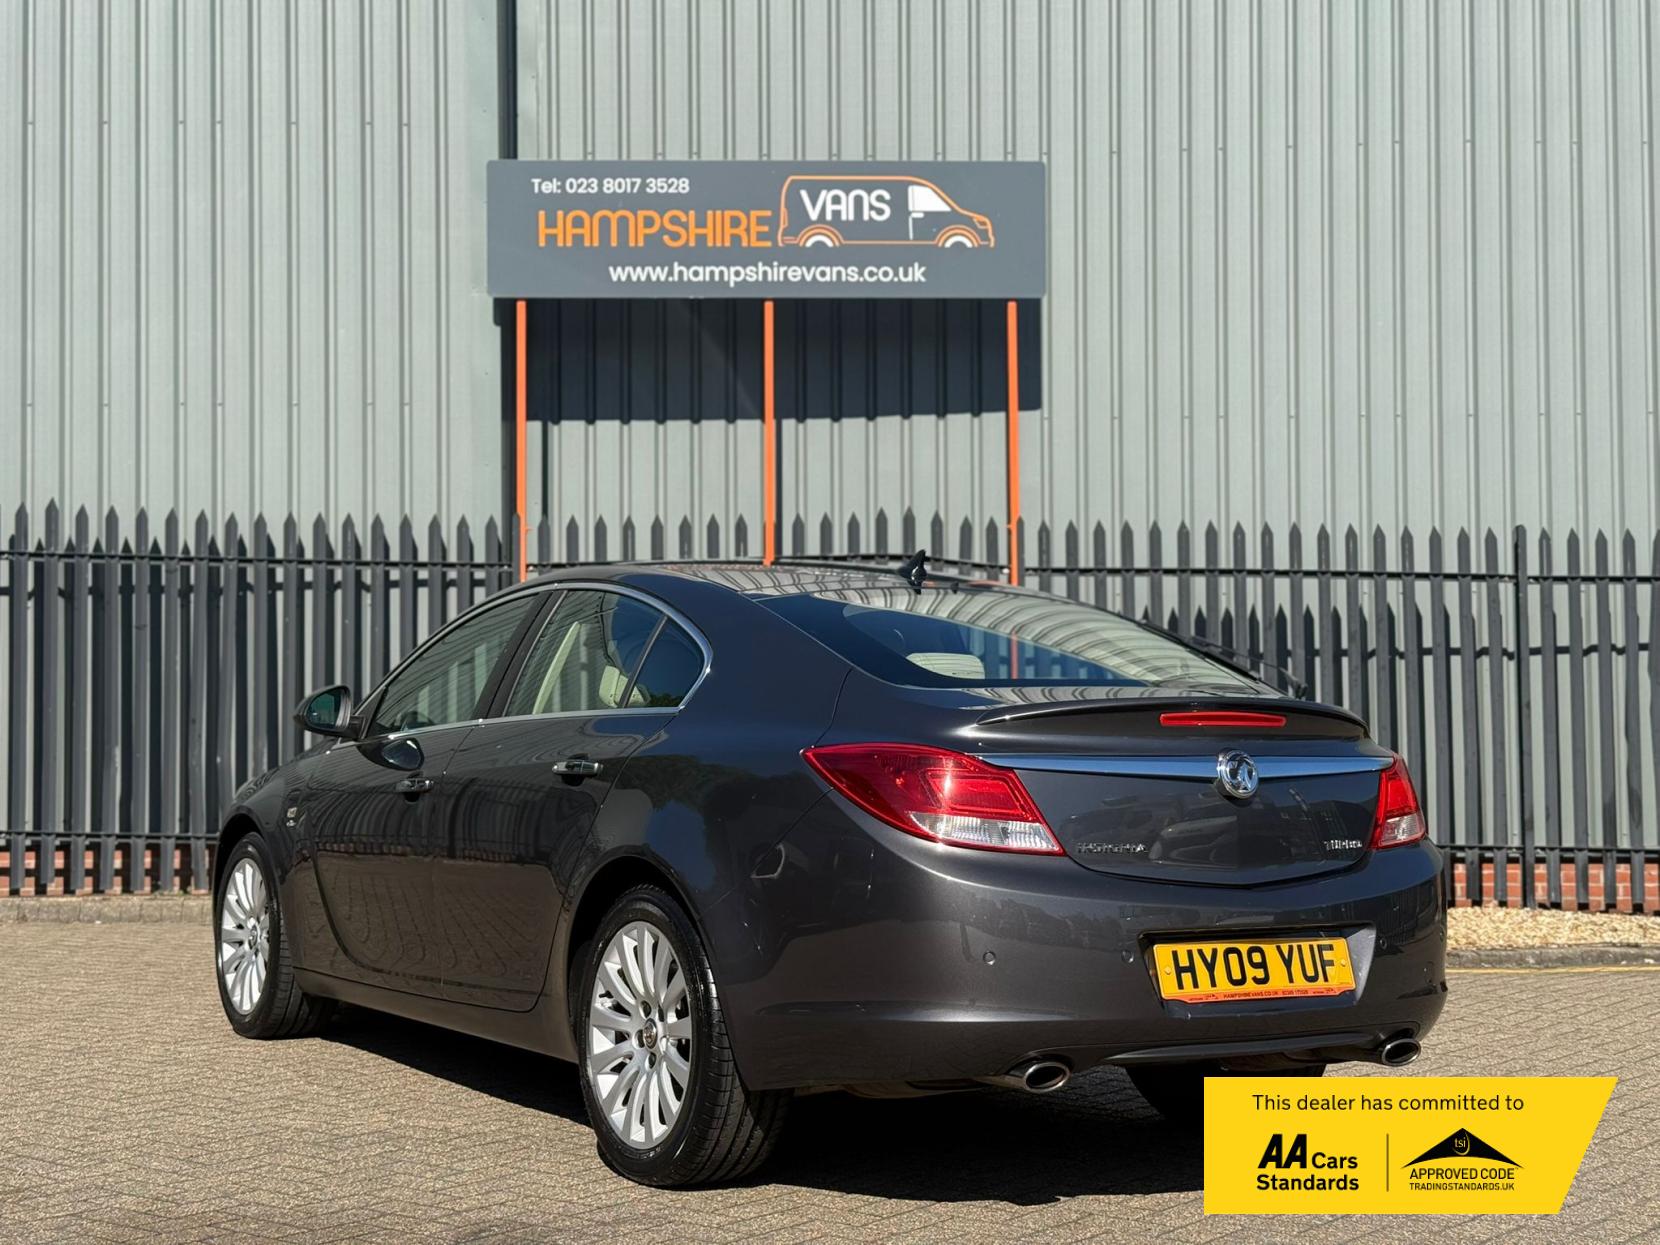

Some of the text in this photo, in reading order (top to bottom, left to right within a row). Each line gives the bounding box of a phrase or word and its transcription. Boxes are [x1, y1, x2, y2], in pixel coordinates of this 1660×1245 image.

[531, 178, 690, 194] Tel: 023 8017 3528
[537, 188, 891, 248] HAMPSHIRE VANS
[608, 262, 927, 288] www.hampshirevans.co.uk
[1172, 943, 1335, 990] HY09 YUF
